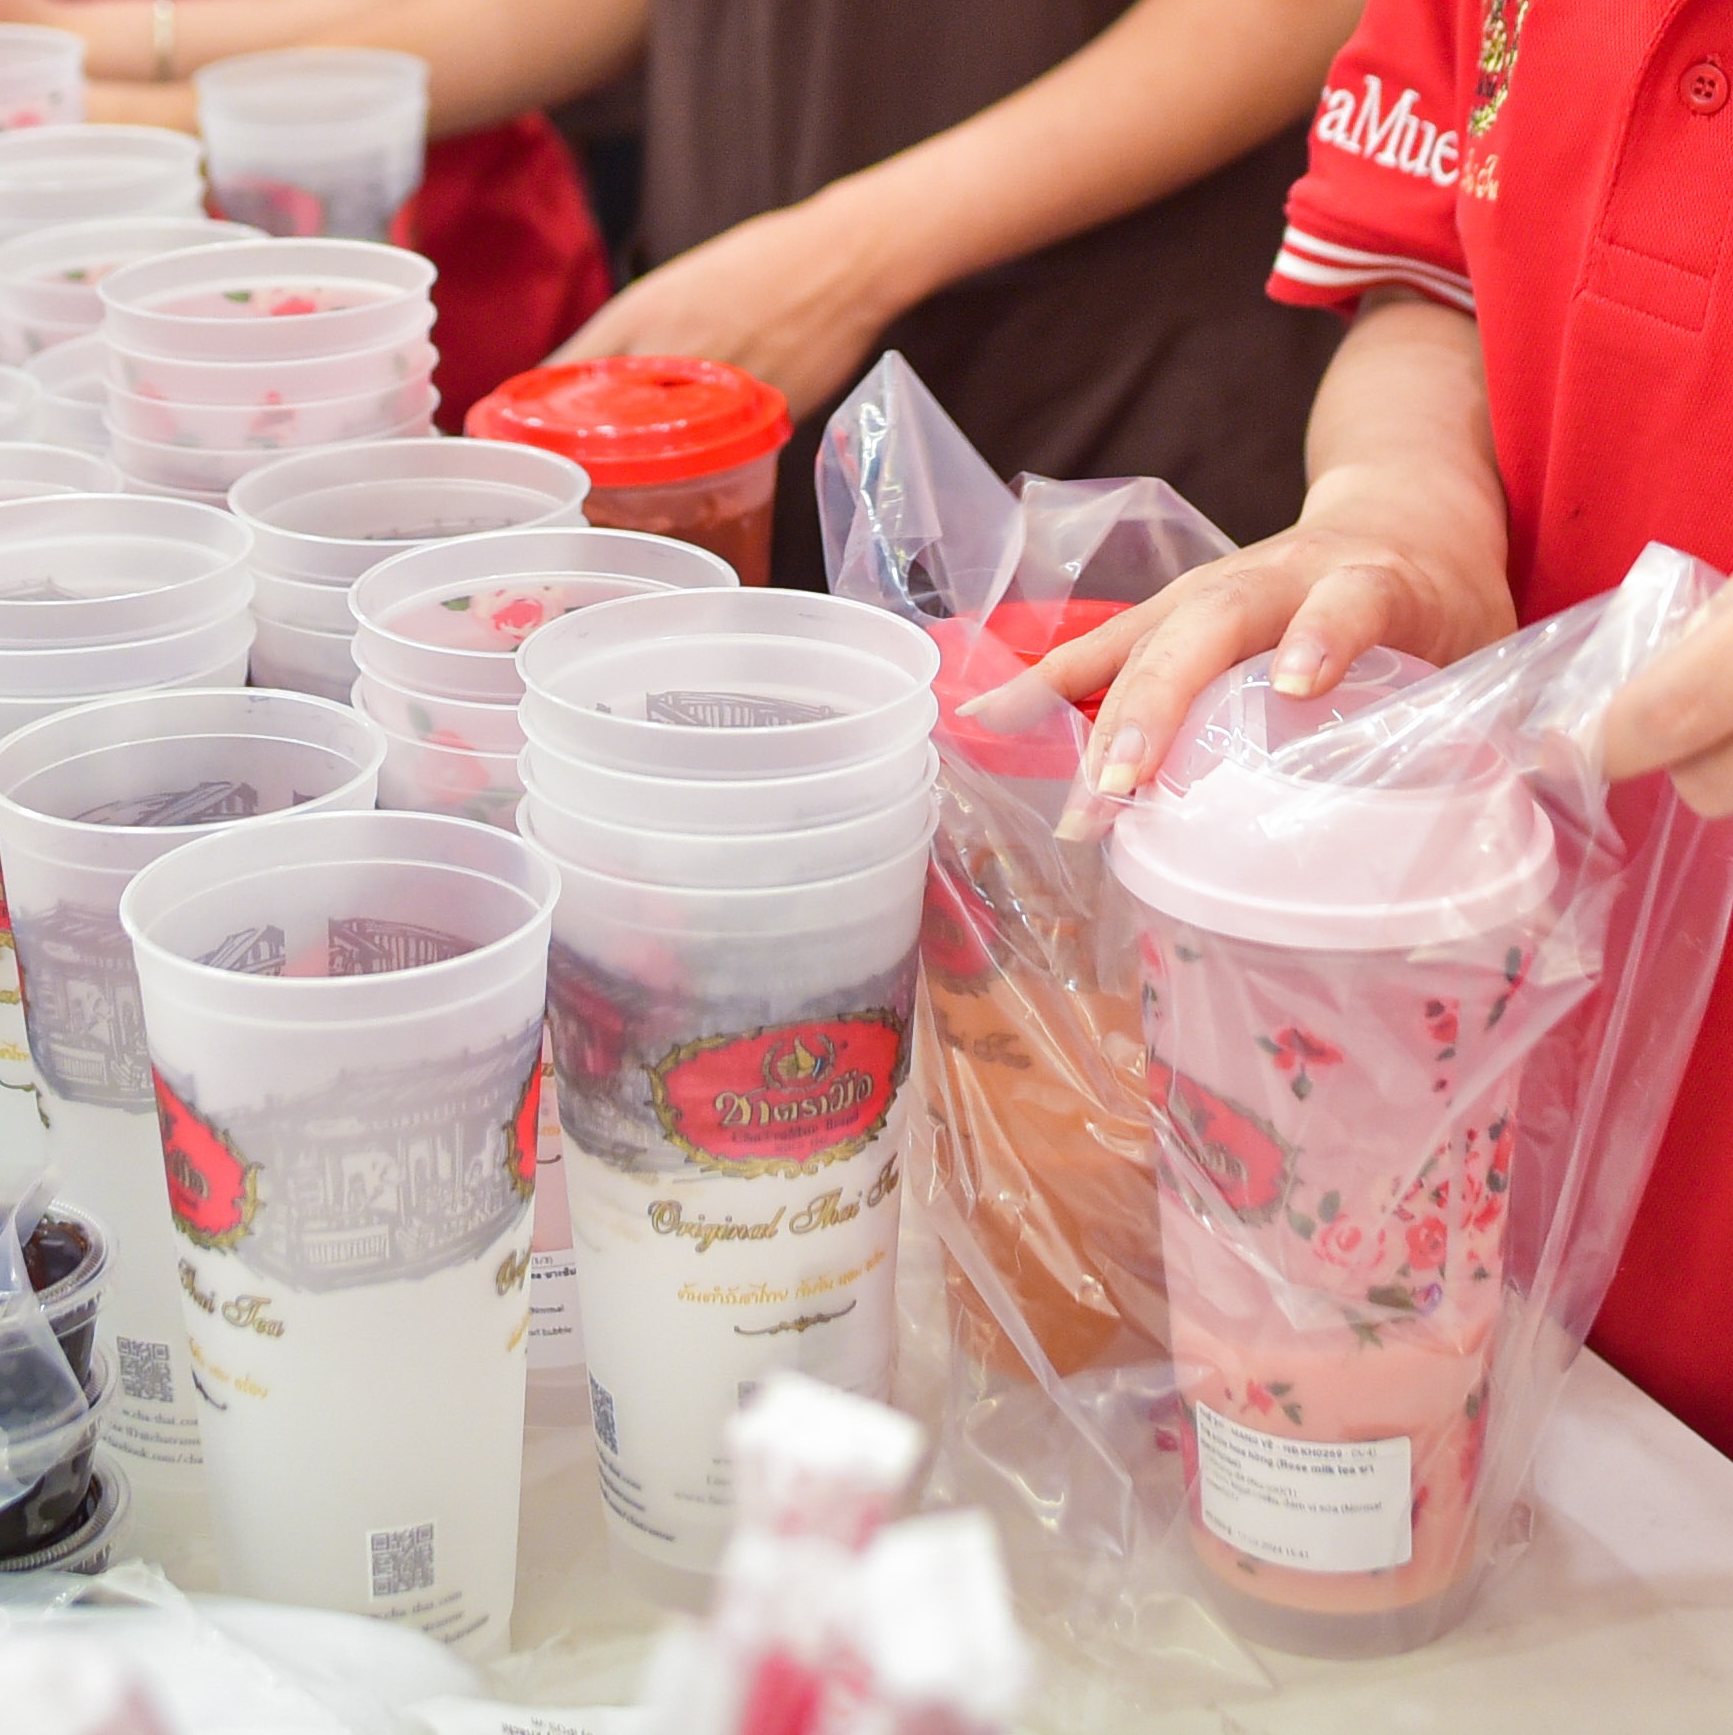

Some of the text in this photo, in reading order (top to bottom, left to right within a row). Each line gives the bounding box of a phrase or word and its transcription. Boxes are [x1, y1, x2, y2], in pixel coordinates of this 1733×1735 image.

[714, 1068, 875, 1127] ชาตรามือ
[647, 1198, 788, 1254] Original
[788, 1186, 864, 1235] Thai
[221, 1293, 286, 1338] Tea
[1310, 1463, 1336, 1475] milk
[1337, 1464, 1356, 1475] tea
